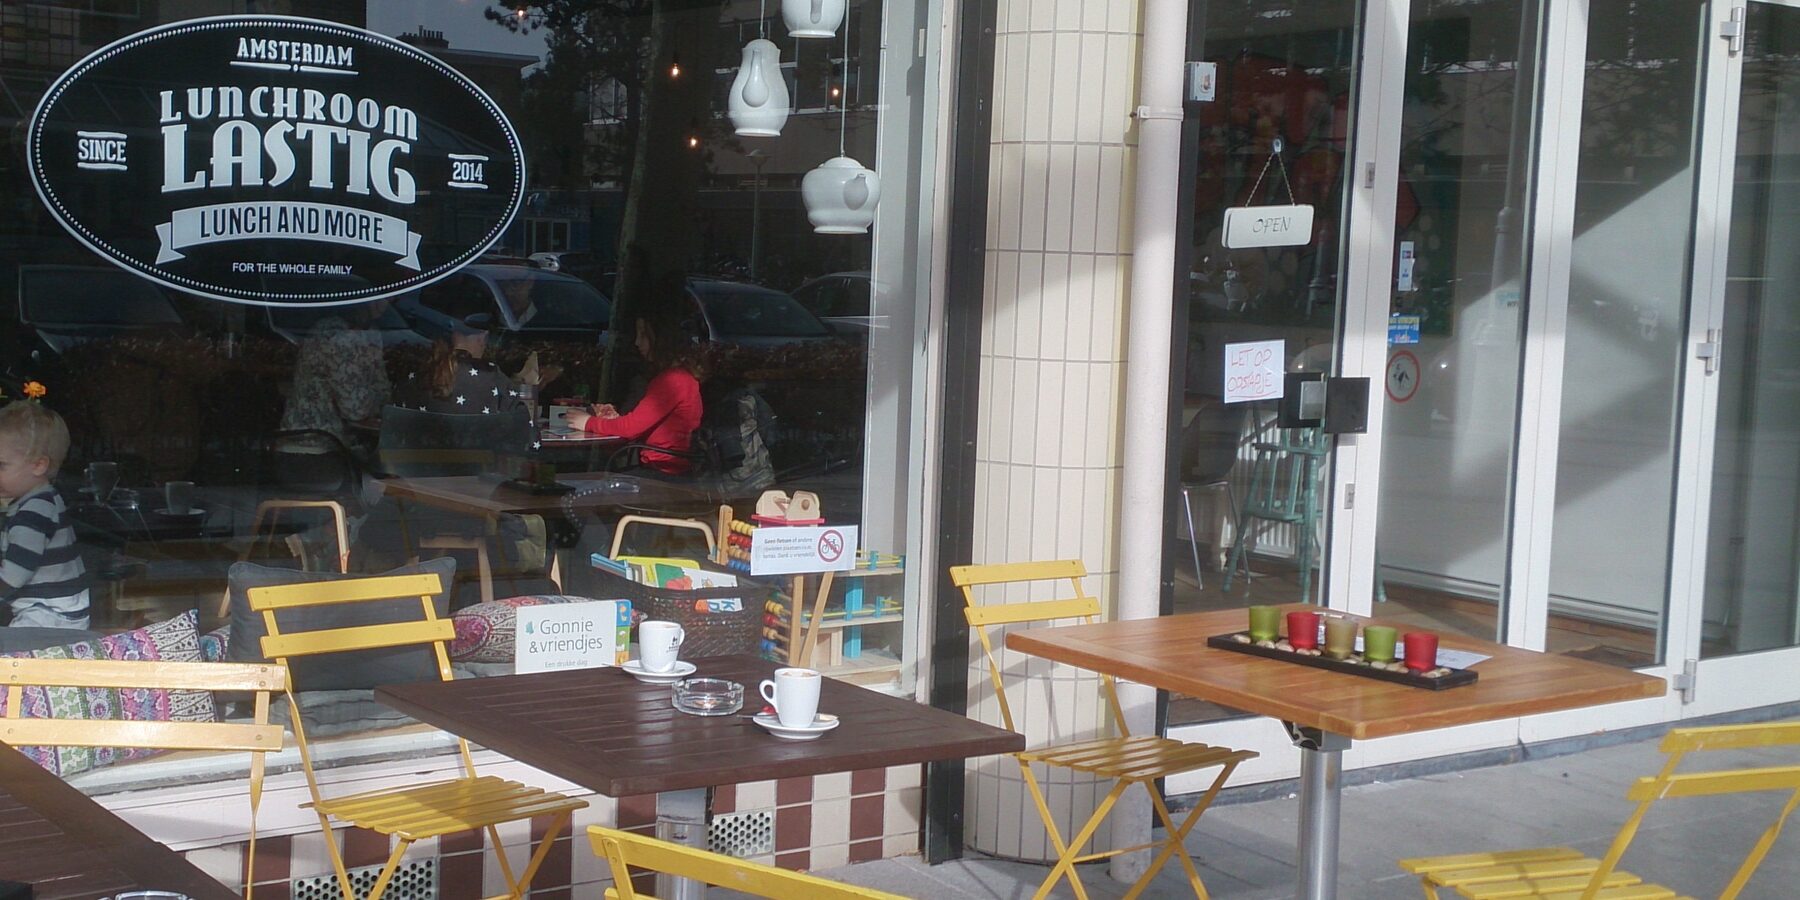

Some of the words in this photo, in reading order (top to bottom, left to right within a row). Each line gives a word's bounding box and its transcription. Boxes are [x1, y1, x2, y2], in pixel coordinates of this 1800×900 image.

[236, 37, 353, 67] AMSTERDAM
[160, 85, 418, 141] LUNCHROOM
[78, 139, 127, 163] SINCE
[161, 119, 417, 204] LASTIG
[452, 162, 483, 183] 2014
[200, 206, 271, 238] LUNCH
[277, 206, 320, 234] AND
[324, 209, 383, 244] MORE
[1252, 216, 1291, 234] OPEN
[232, 262, 255, 273] FOR
[256, 263, 277, 274] THE
[279, 263, 316, 275] WHOLE
[318, 264, 353, 275] FAMILY
[1231, 348, 1254, 366] LET
[540, 617, 594, 635] Gonnie
